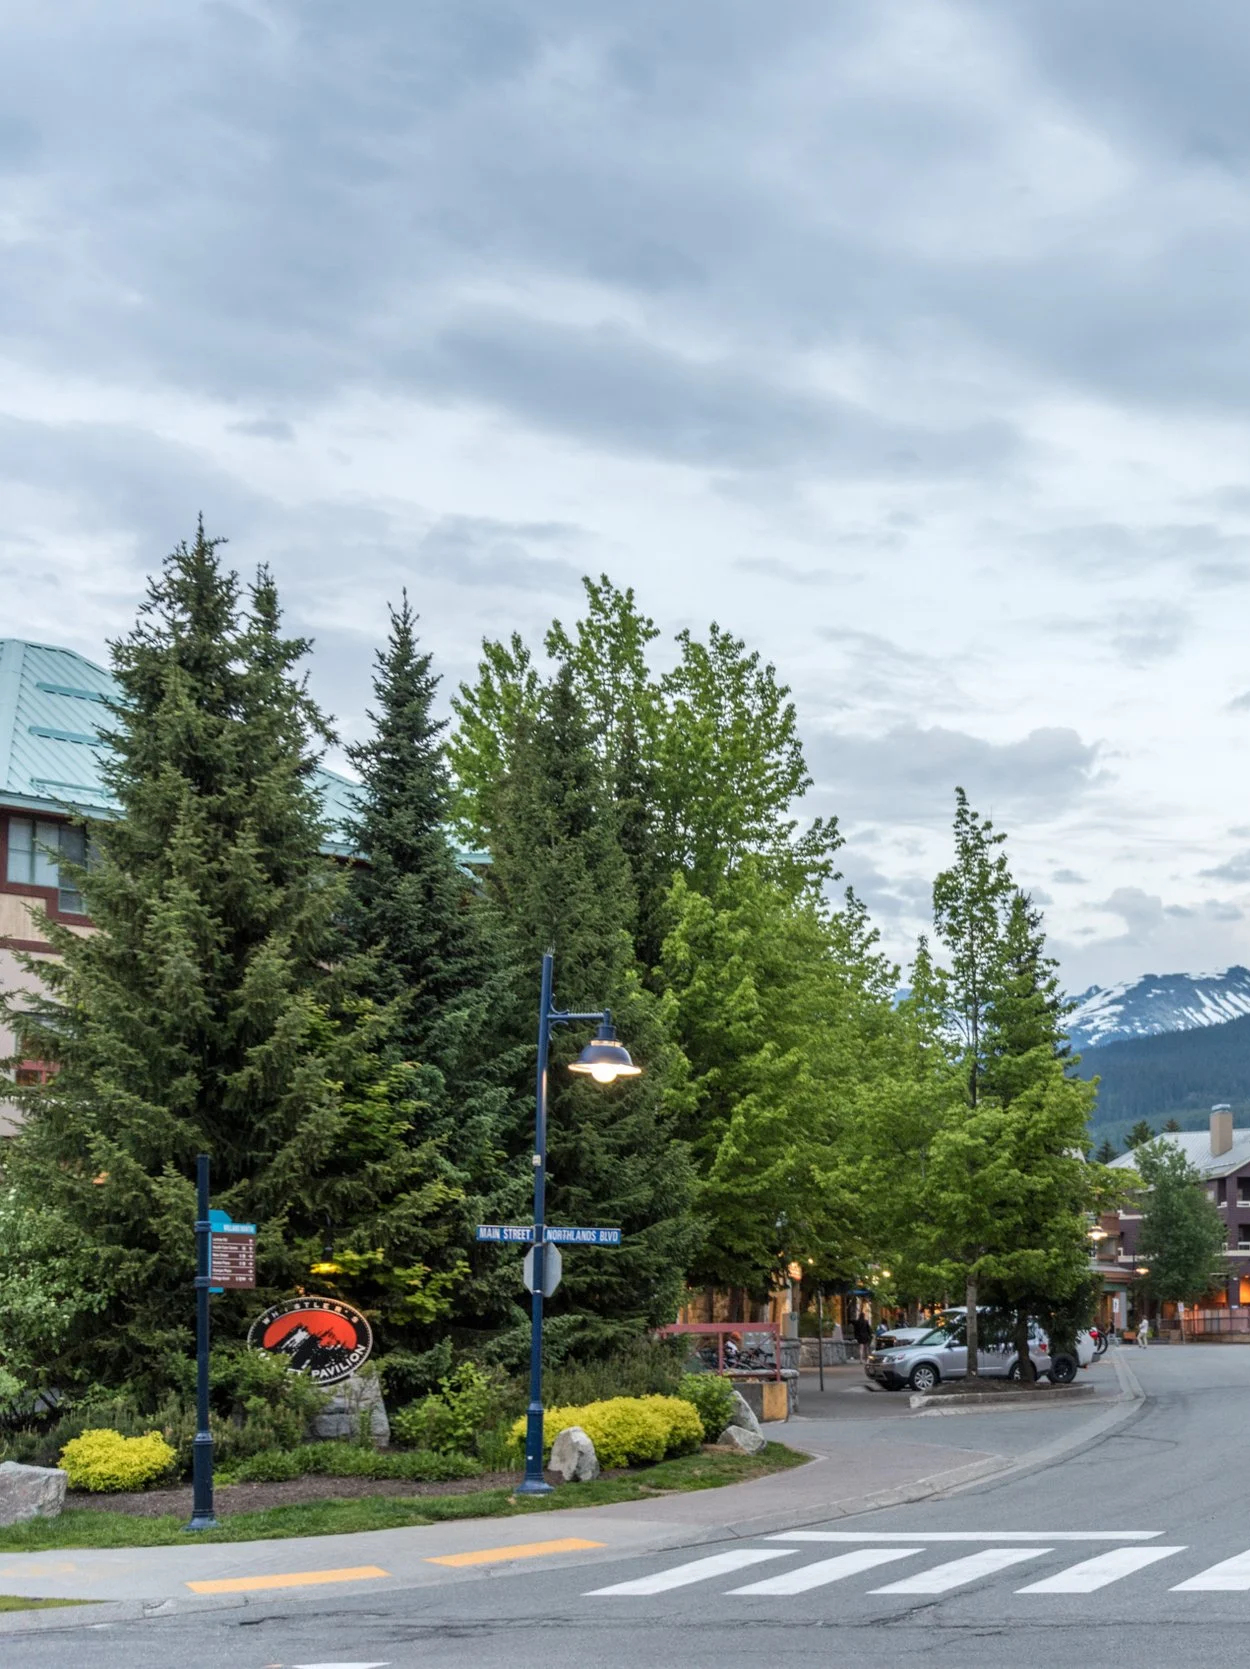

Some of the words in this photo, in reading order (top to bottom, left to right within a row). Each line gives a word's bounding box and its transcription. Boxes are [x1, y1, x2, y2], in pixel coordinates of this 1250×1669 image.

[479, 1227, 500, 1239] MAIN
[503, 1229, 530, 1240] STREET
[546, 1230, 596, 1241] NORTHLANDS
[600, 1231, 619, 1241] BLVD
[311, 1343, 367, 1379] PAVILION
